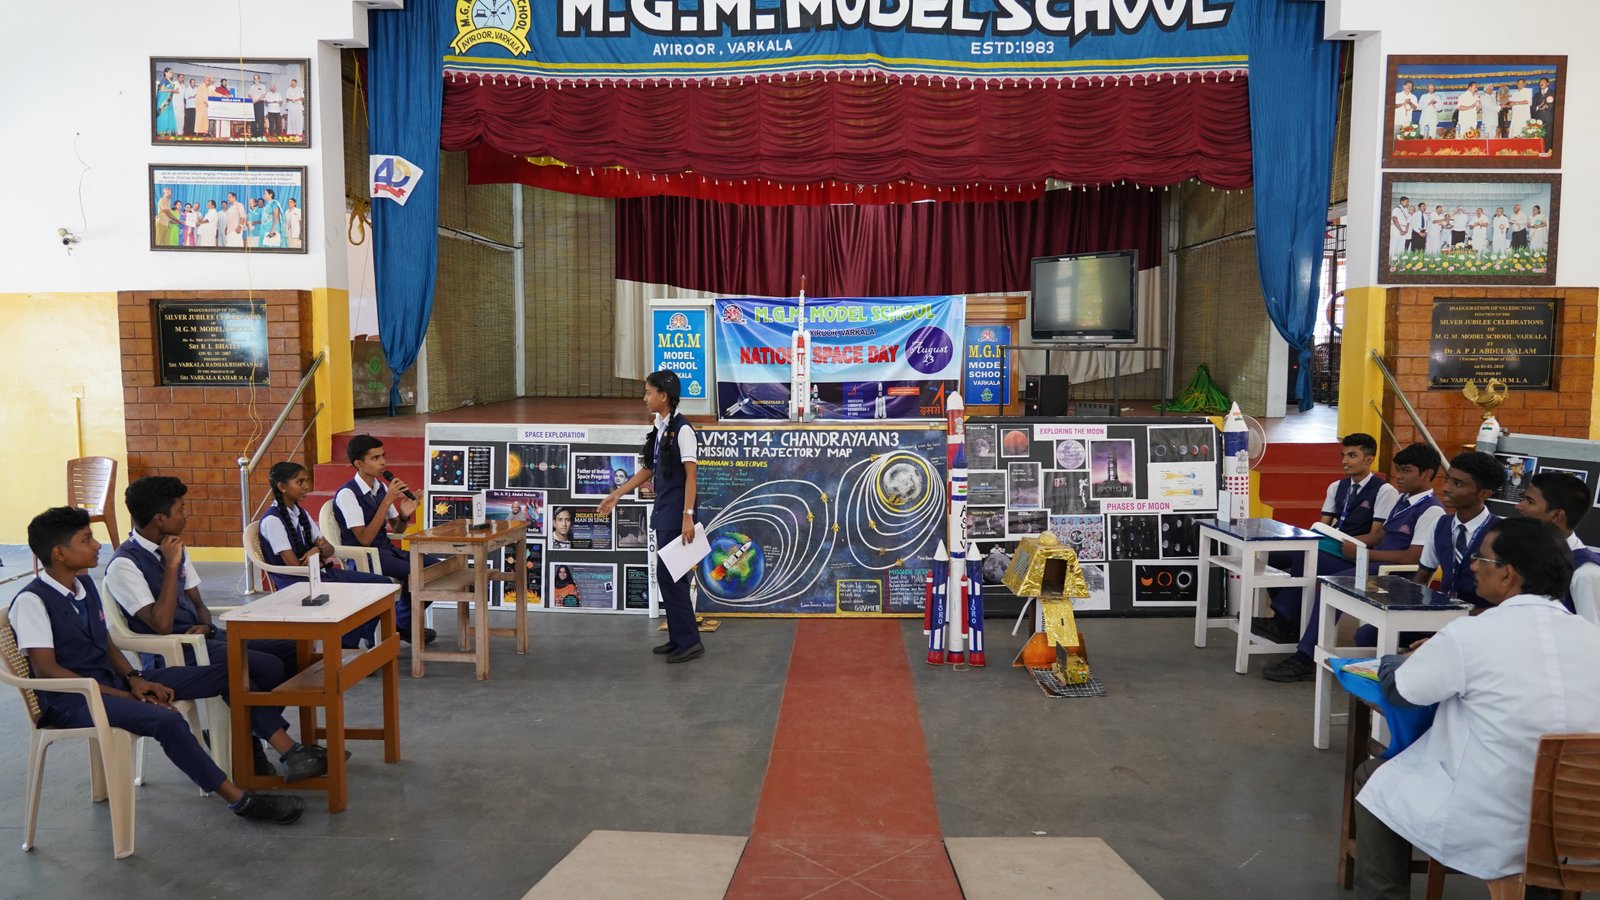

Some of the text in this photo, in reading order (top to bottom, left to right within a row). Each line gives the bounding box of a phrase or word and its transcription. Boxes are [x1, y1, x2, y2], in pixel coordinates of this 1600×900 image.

[727, 39, 793, 54] VARKALA
[970, 41, 1055, 55] ESTD:1983
[810, 305, 867, 323] MODEL
[871, 304, 936, 323] SCHOOL
[842, 327, 876, 337] VARKALA
[658, 333, 701, 348] M.G.M
[664, 351, 695, 360] MODEL
[812, 344, 863, 365] SPACE
[868, 344, 900, 364] DAY
[910, 341, 949, 356] August
[661, 361, 698, 370] SCHOOL
[922, 355, 935, 366] 23
[698, 447, 853, 458] MISSION TRAJECTORY MAP
